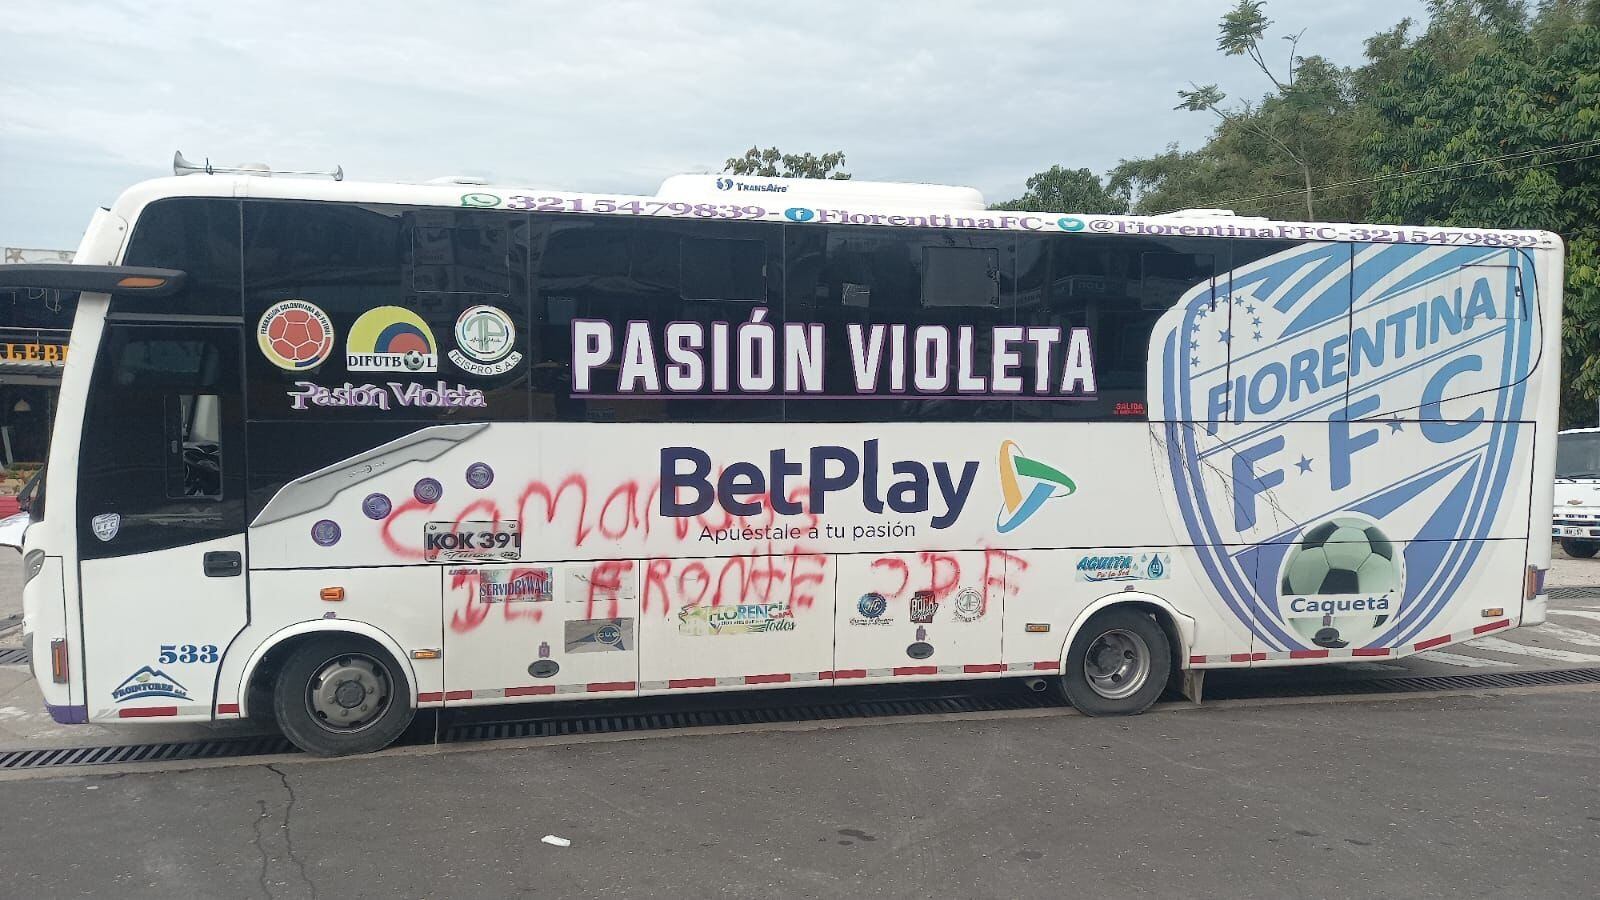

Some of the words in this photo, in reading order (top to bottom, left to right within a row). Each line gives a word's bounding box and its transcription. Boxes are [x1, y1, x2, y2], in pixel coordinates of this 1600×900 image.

[571, 306, 826, 393] PASIÓN
[846, 323, 1099, 394] VIOLETA
[1206, 277, 1497, 436] FIORENTINA
[450, 350, 493, 375] TEISPRO
[287, 381, 391, 411] Pasión
[386, 380, 488, 408] Violeta
[1115, 402, 1144, 410] SALIDA
[659, 438, 980, 529] BetPlay
[427, 533, 475, 550] KOK
[480, 532, 521, 548] 391
[699, 523, 802, 544] Apuéstale
[808, 528, 819, 539] a
[826, 523, 846, 538] tu
[852, 521, 916, 541] pasión
[1290, 595, 1389, 615] Caquetá
[159, 644, 219, 664] 533
